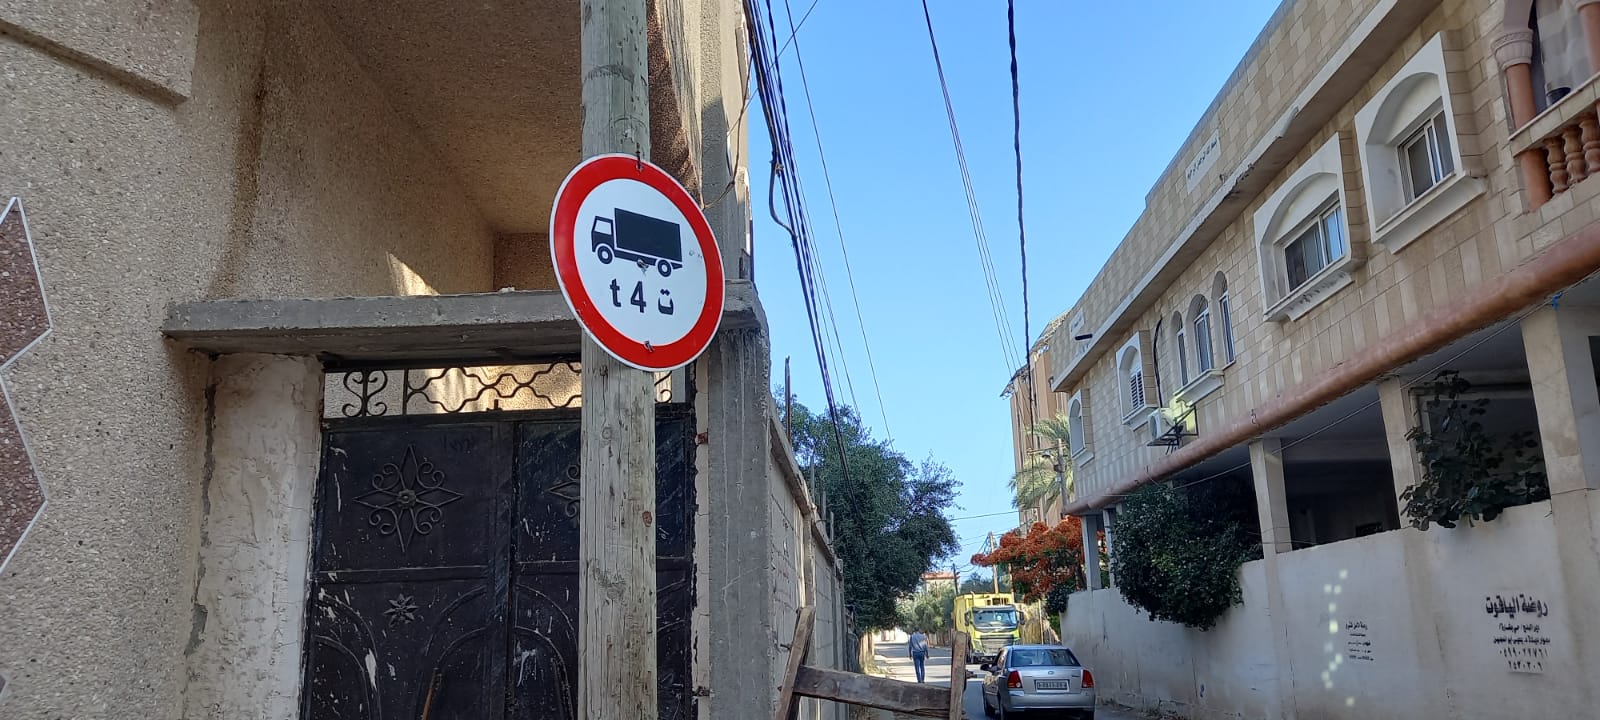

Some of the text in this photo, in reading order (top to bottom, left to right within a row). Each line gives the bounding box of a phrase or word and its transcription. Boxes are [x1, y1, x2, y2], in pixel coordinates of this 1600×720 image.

[610, 278, 674, 315] t 4 ت
